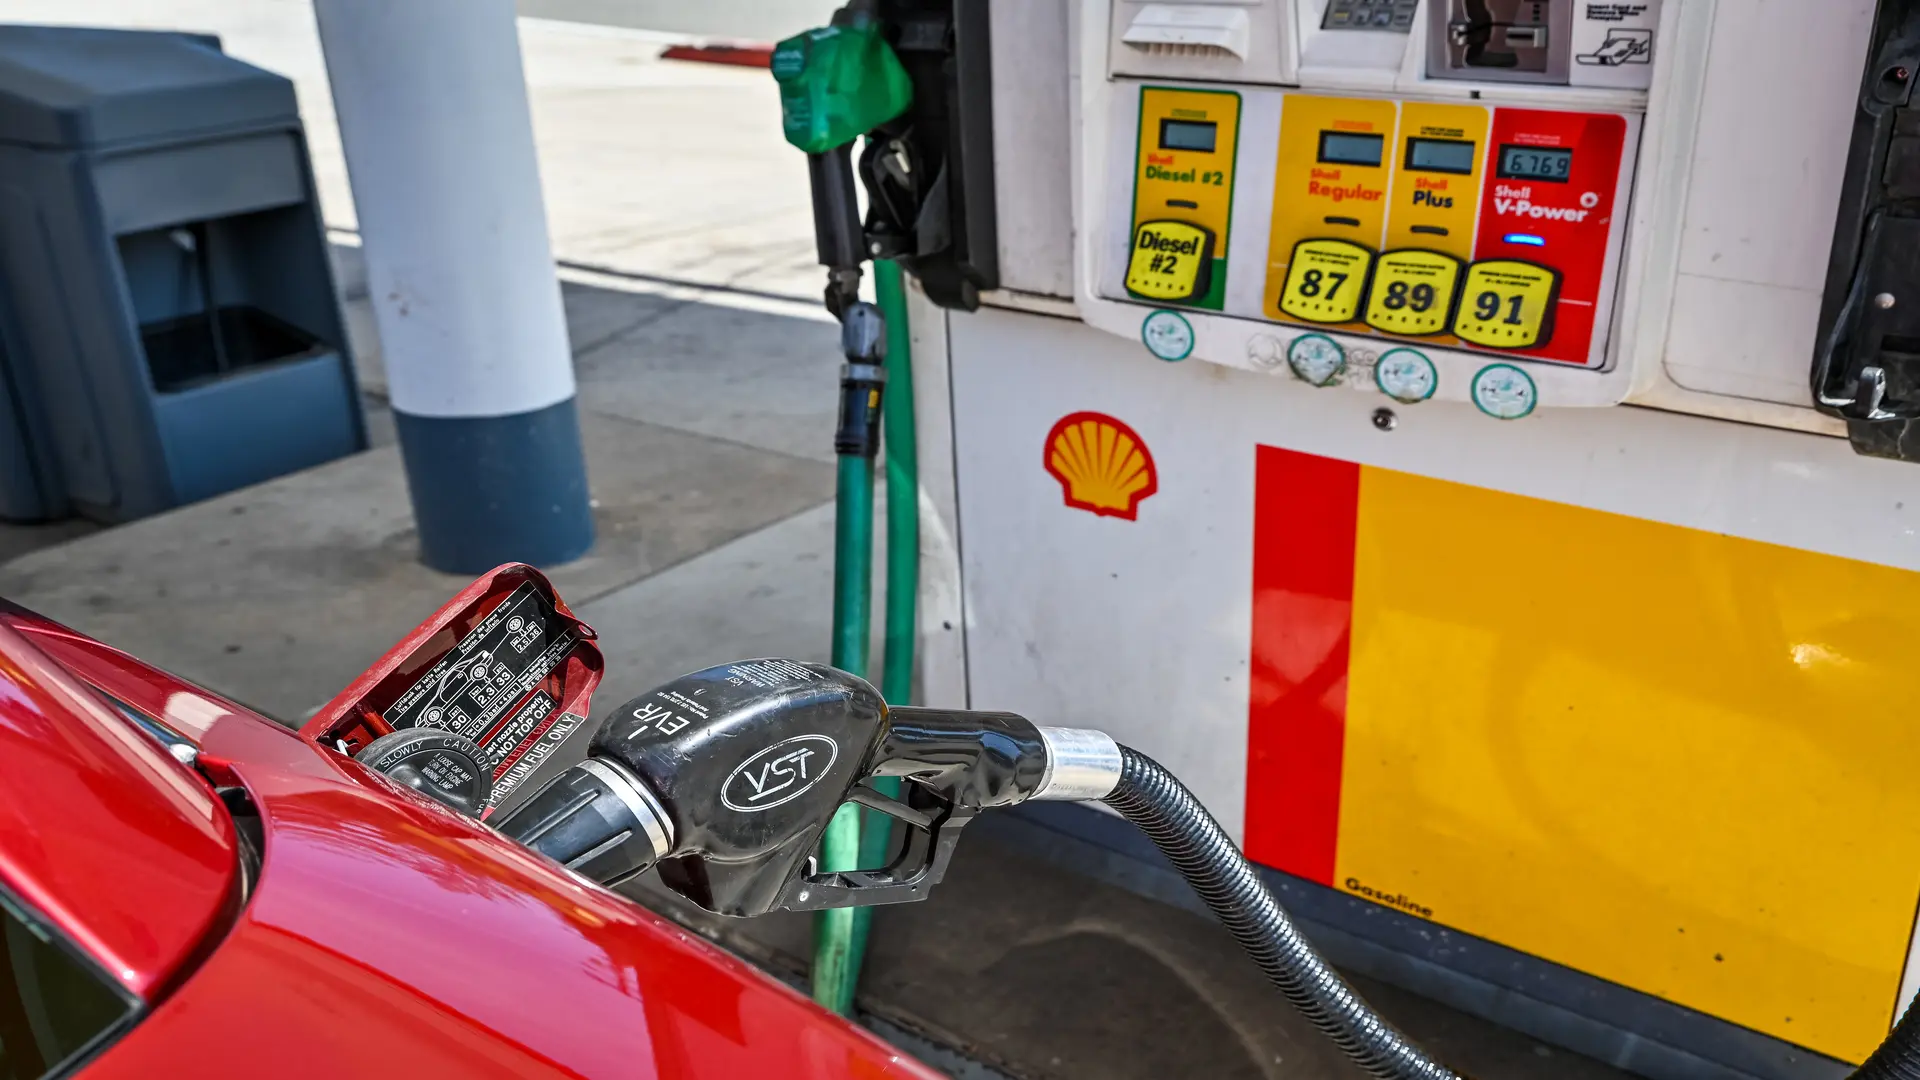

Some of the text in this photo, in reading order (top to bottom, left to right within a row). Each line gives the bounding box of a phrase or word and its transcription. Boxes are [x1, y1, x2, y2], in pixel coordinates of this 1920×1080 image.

[1148, 153, 1174, 165] Shell
[1146, 166, 1224, 186] Diesel #2
[1311, 168, 1342, 181] Shell
[1415, 178, 1448, 190] Shell
[1308, 181, 1383, 202] Regular
[1413, 190, 1453, 208] Plus
[1494, 185, 1531, 199] Shell
[1494, 198, 1588, 223] V-Power
[1139, 230, 1200, 256] Diesel
[1149, 256, 1178, 274] #2
[1298, 268, 1348, 301] 87
[1384, 281, 1435, 313] 89
[1474, 291, 1524, 325] 91
[517, 638, 529, 651] 2,5
[530, 629, 540, 639] 36
[496, 672, 511, 686] 33
[477, 687, 495, 705] 2,3
[452, 714, 467, 730] 30
[496, 699, 552, 757] NOT TOP OFF
[497, 721, 518, 741] nozzle
[517, 695, 544, 724] properly
[633, 703, 690, 735] EVR
[380, 740, 423, 768] SLOWLY
[443, 738, 490, 772] CAUTION
[488, 762, 532, 804] PREMIUM
[524, 742, 554, 764] FUEL
[548, 715, 576, 741] ONLY
[744, 748, 815, 801] VST
[1345, 878, 1433, 917] Gasoline
